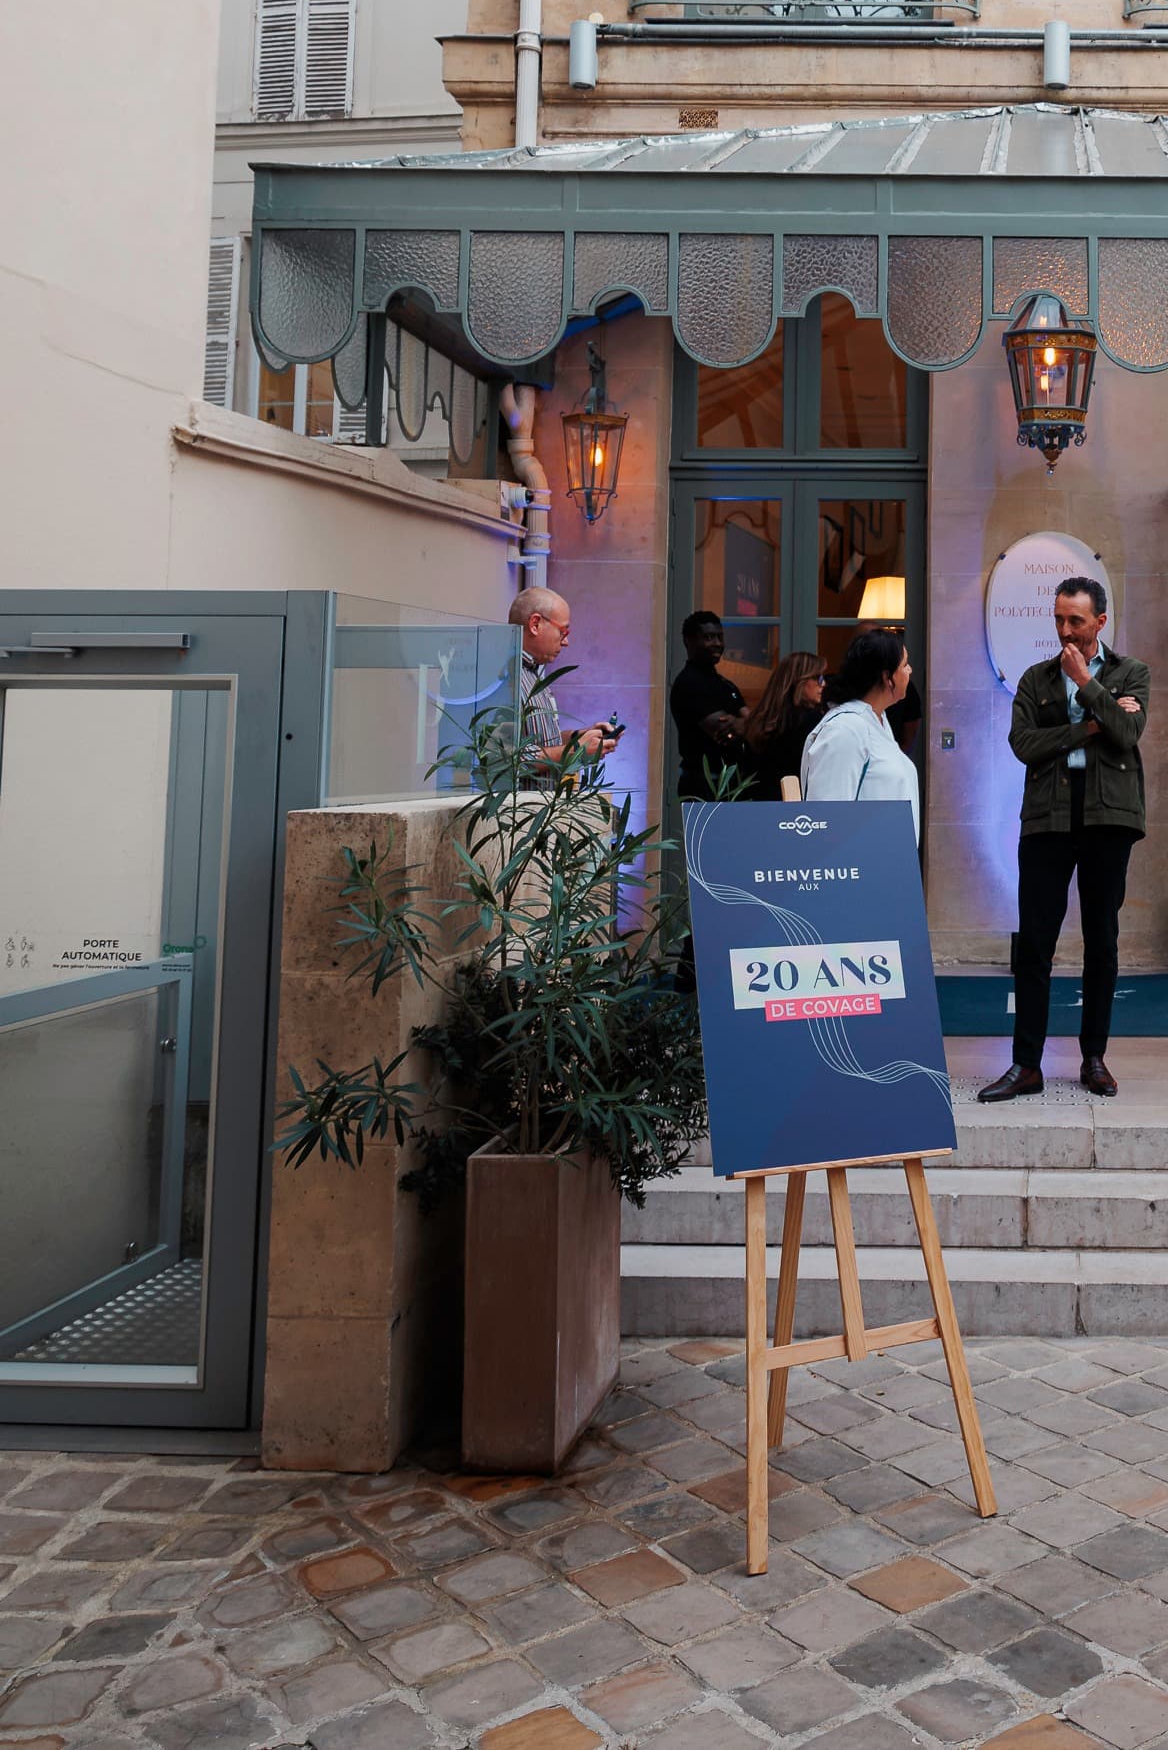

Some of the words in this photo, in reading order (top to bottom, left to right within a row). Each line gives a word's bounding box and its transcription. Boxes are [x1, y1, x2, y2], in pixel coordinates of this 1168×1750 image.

[1024, 564, 1074, 574] MAISON
[1037, 586, 1057, 596] DE
[754, 868, 860, 882] BIENVENUE
[798, 883, 819, 891] AUX
[83, 939, 120, 948] PORTE
[61, 951, 142, 962] AUTOMATIQUE
[746, 961, 800, 992] 20
[813, 954, 892, 989] ANS
[771, 1002, 797, 1018] DE
[802, 997, 876, 1016] COVAGE
